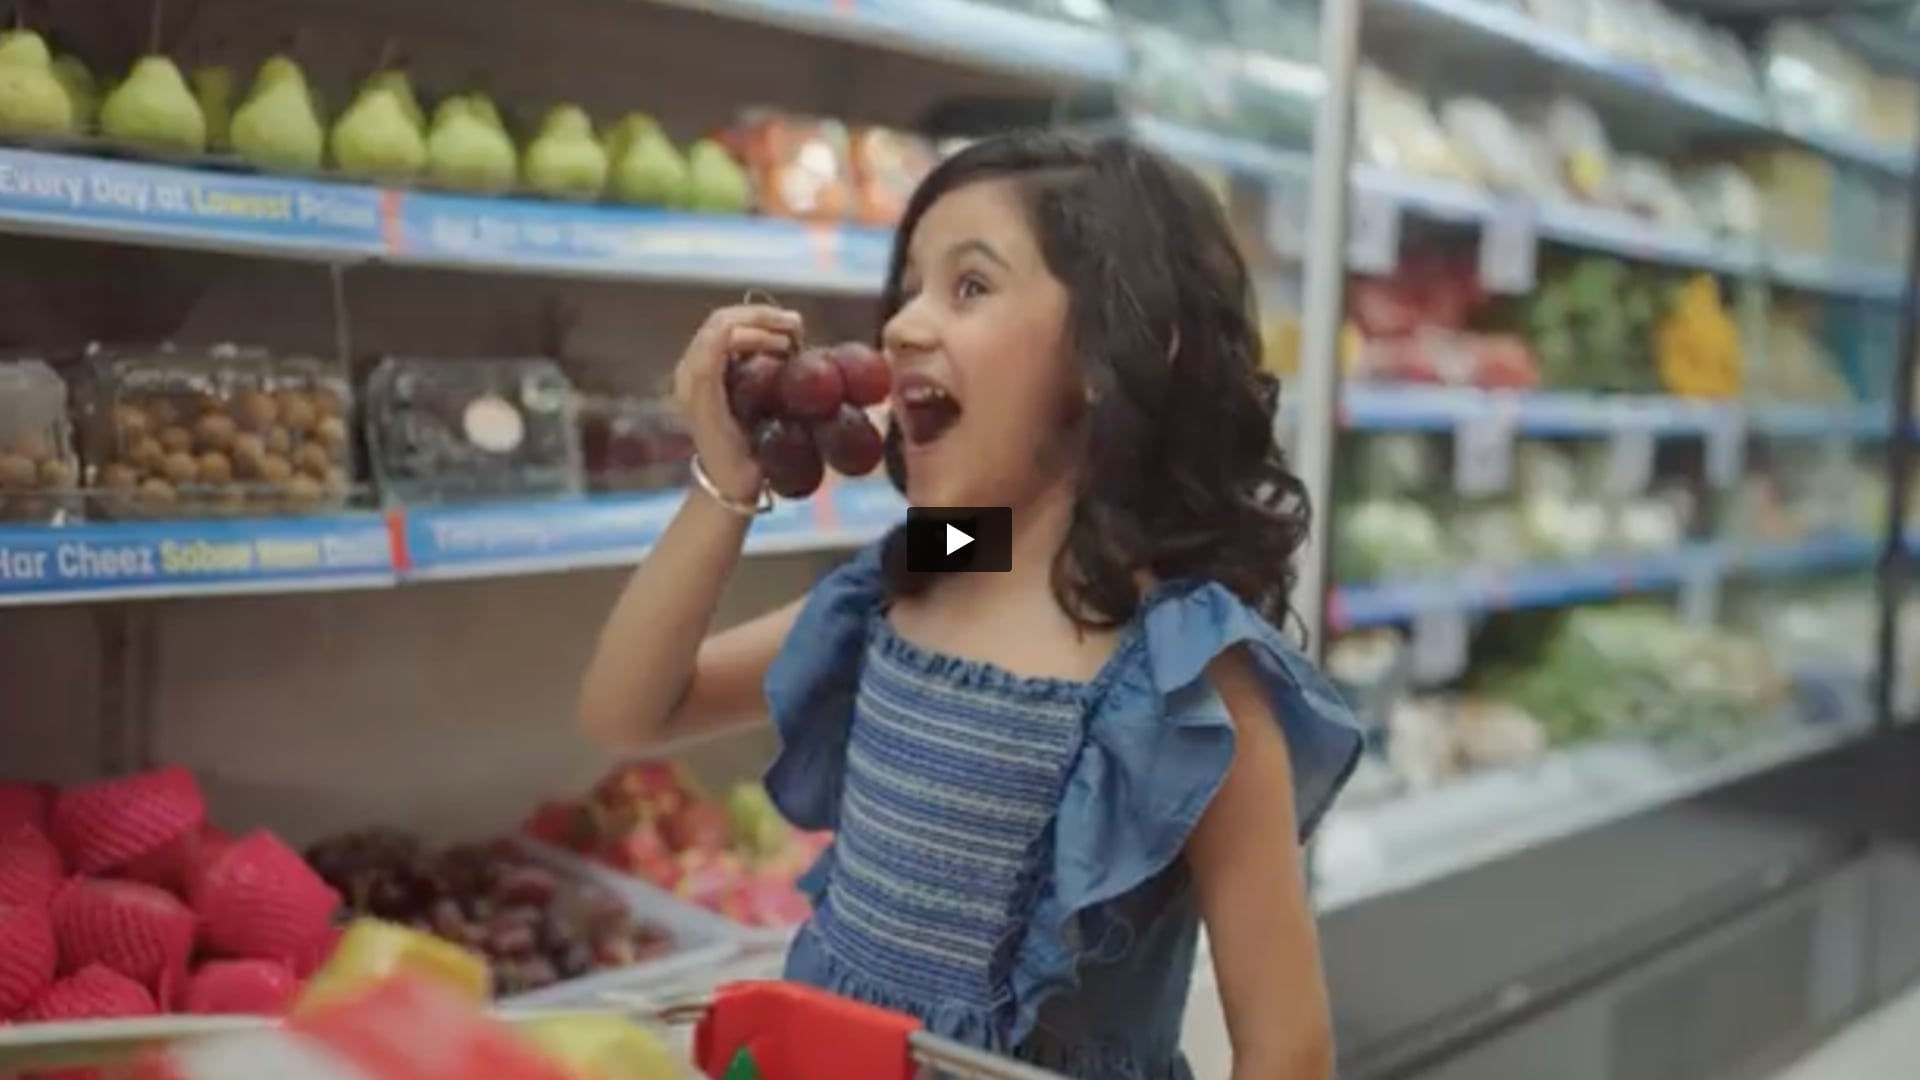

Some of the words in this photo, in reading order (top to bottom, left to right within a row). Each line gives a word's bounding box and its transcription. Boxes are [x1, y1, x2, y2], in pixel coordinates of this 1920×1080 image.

[0, 164, 84, 208] Every
[93, 174, 150, 213] Day
[156, 185, 187, 212] at
[57, 542, 155, 578] Cheez
